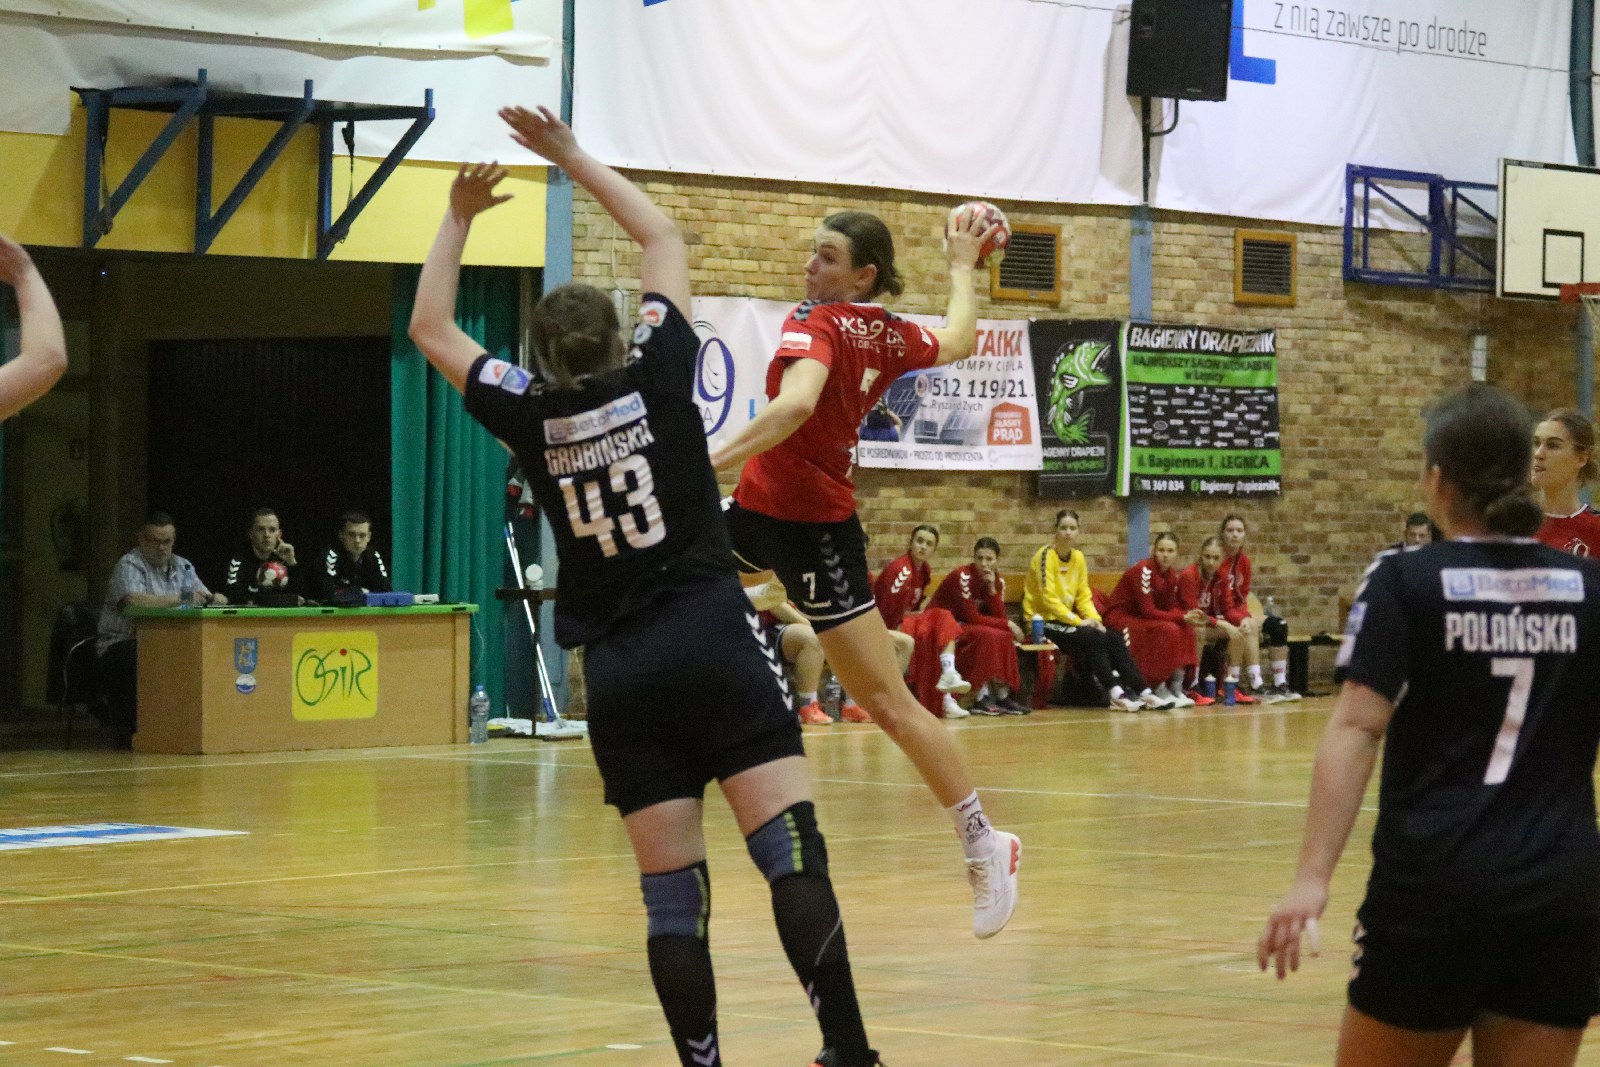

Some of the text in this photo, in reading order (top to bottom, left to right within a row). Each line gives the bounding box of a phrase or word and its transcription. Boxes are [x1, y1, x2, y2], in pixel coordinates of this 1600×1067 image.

[1274, 2, 1487, 56] z nią zawsze po drodze
[932, 378, 960, 397] 512
[963, 401, 983, 413] Zych
[993, 428, 1023, 444] PRĄD
[1149, 454, 1205, 472] Bagienna
[1221, 455, 1270, 469] LEGNICA
[559, 454, 666, 557] 43
[802, 572, 815, 600] 7
[1446, 606, 1577, 653] POLAŃSKA
[1484, 657, 1534, 785] 7
